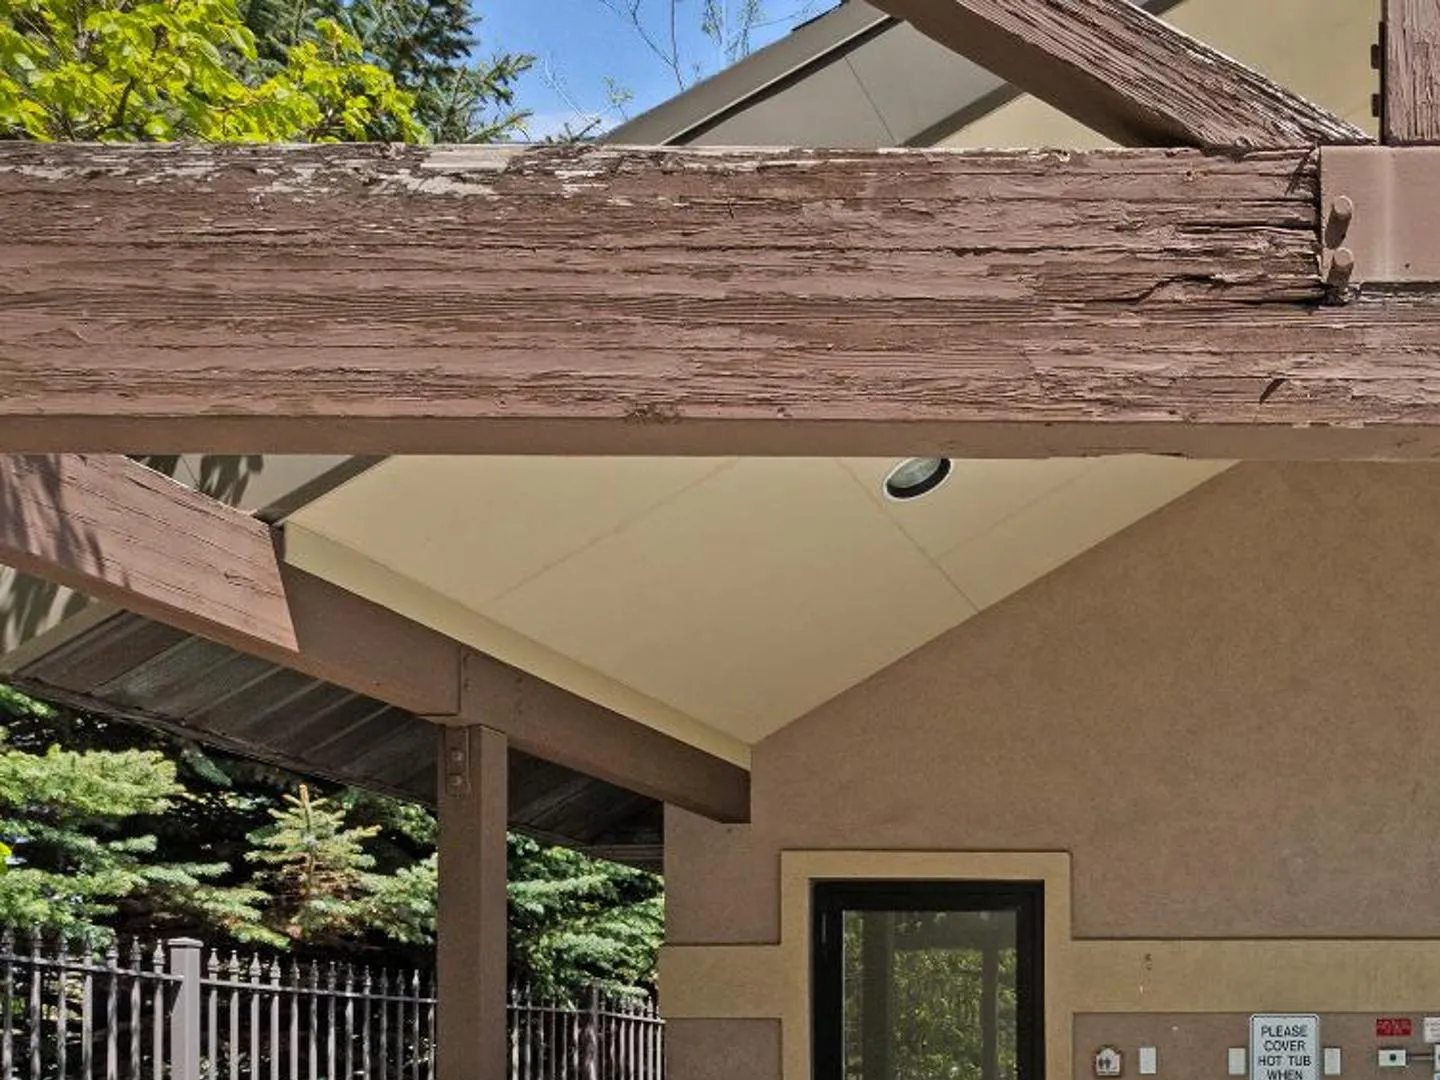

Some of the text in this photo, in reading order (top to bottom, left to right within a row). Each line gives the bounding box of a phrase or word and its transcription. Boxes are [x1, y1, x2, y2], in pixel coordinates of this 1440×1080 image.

[1261, 1024, 1308, 1038] PLEASE
[1263, 1040, 1306, 1052] COVER
[1258, 1055, 1312, 1066] HOT TUB
[1266, 1069, 1303, 1080] WHEN
